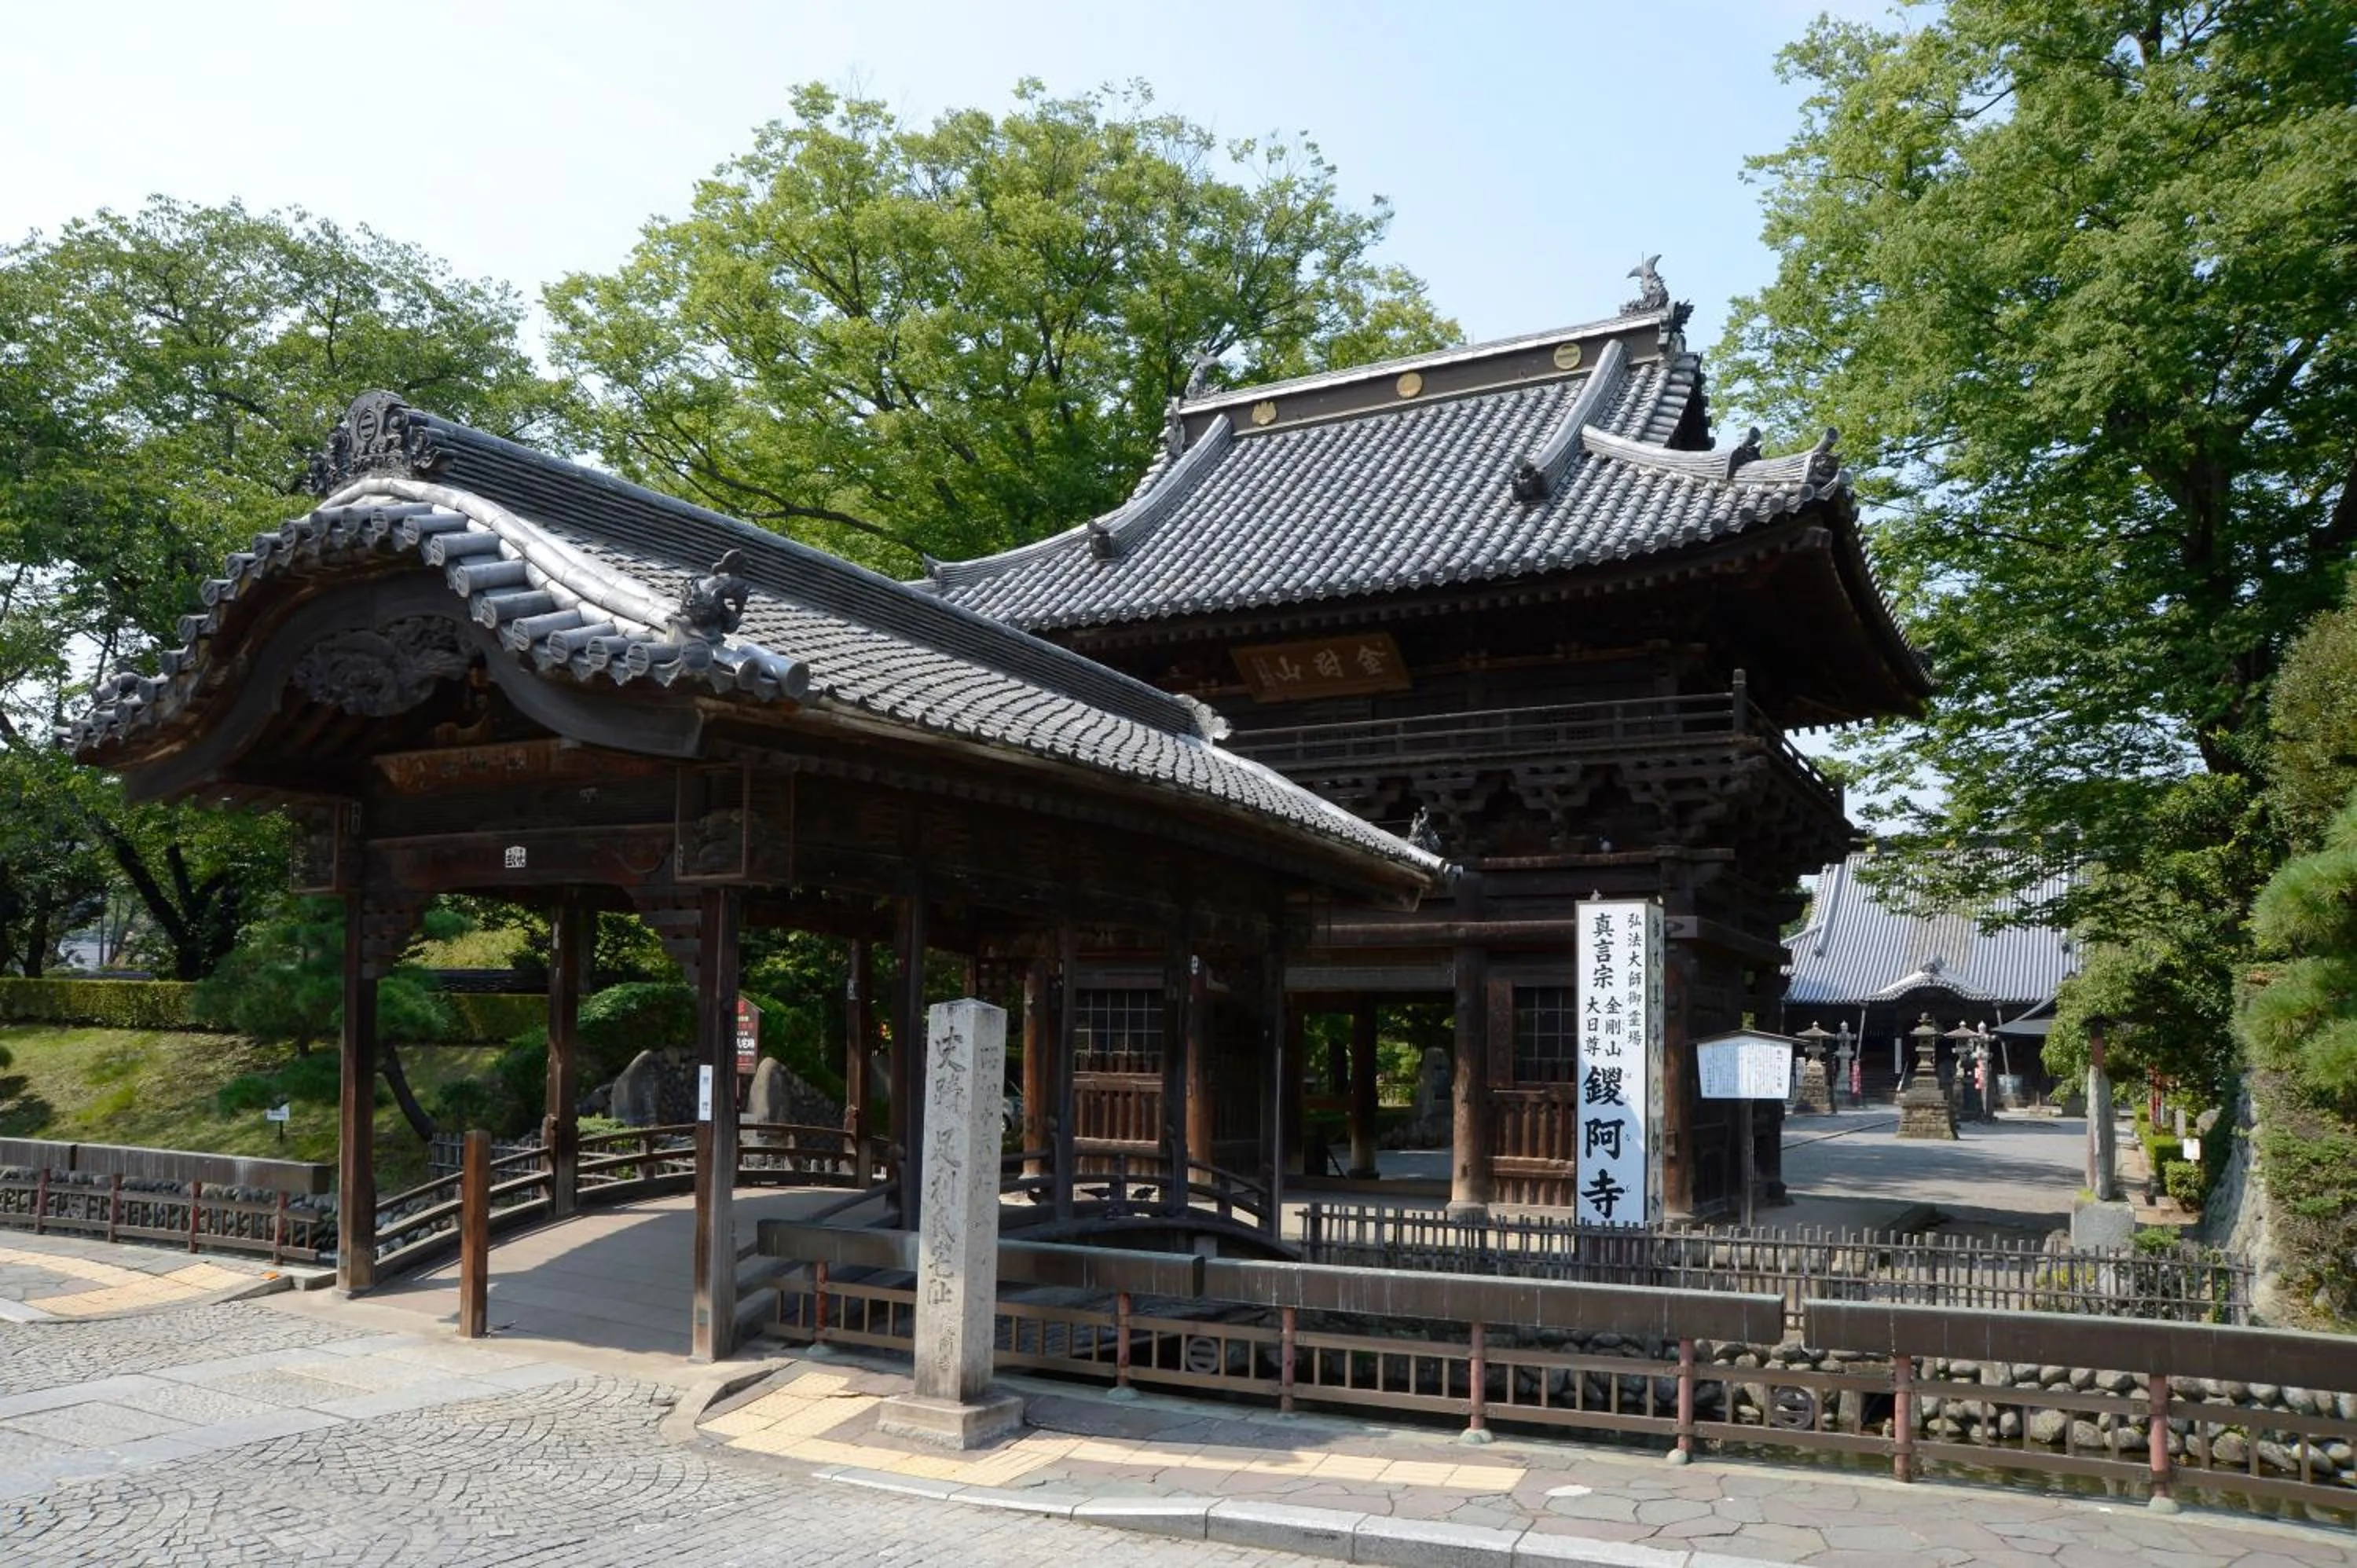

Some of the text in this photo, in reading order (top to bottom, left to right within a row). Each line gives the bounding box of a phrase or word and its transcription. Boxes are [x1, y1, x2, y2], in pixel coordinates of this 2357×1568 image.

[1593, 912, 1615, 989] 真言宗
[1584, 995, 1601, 1057] 大日尊
[1604, 995, 1622, 1057] 金剛山
[1581, 1065, 1625, 1218] 鑁阿寺
